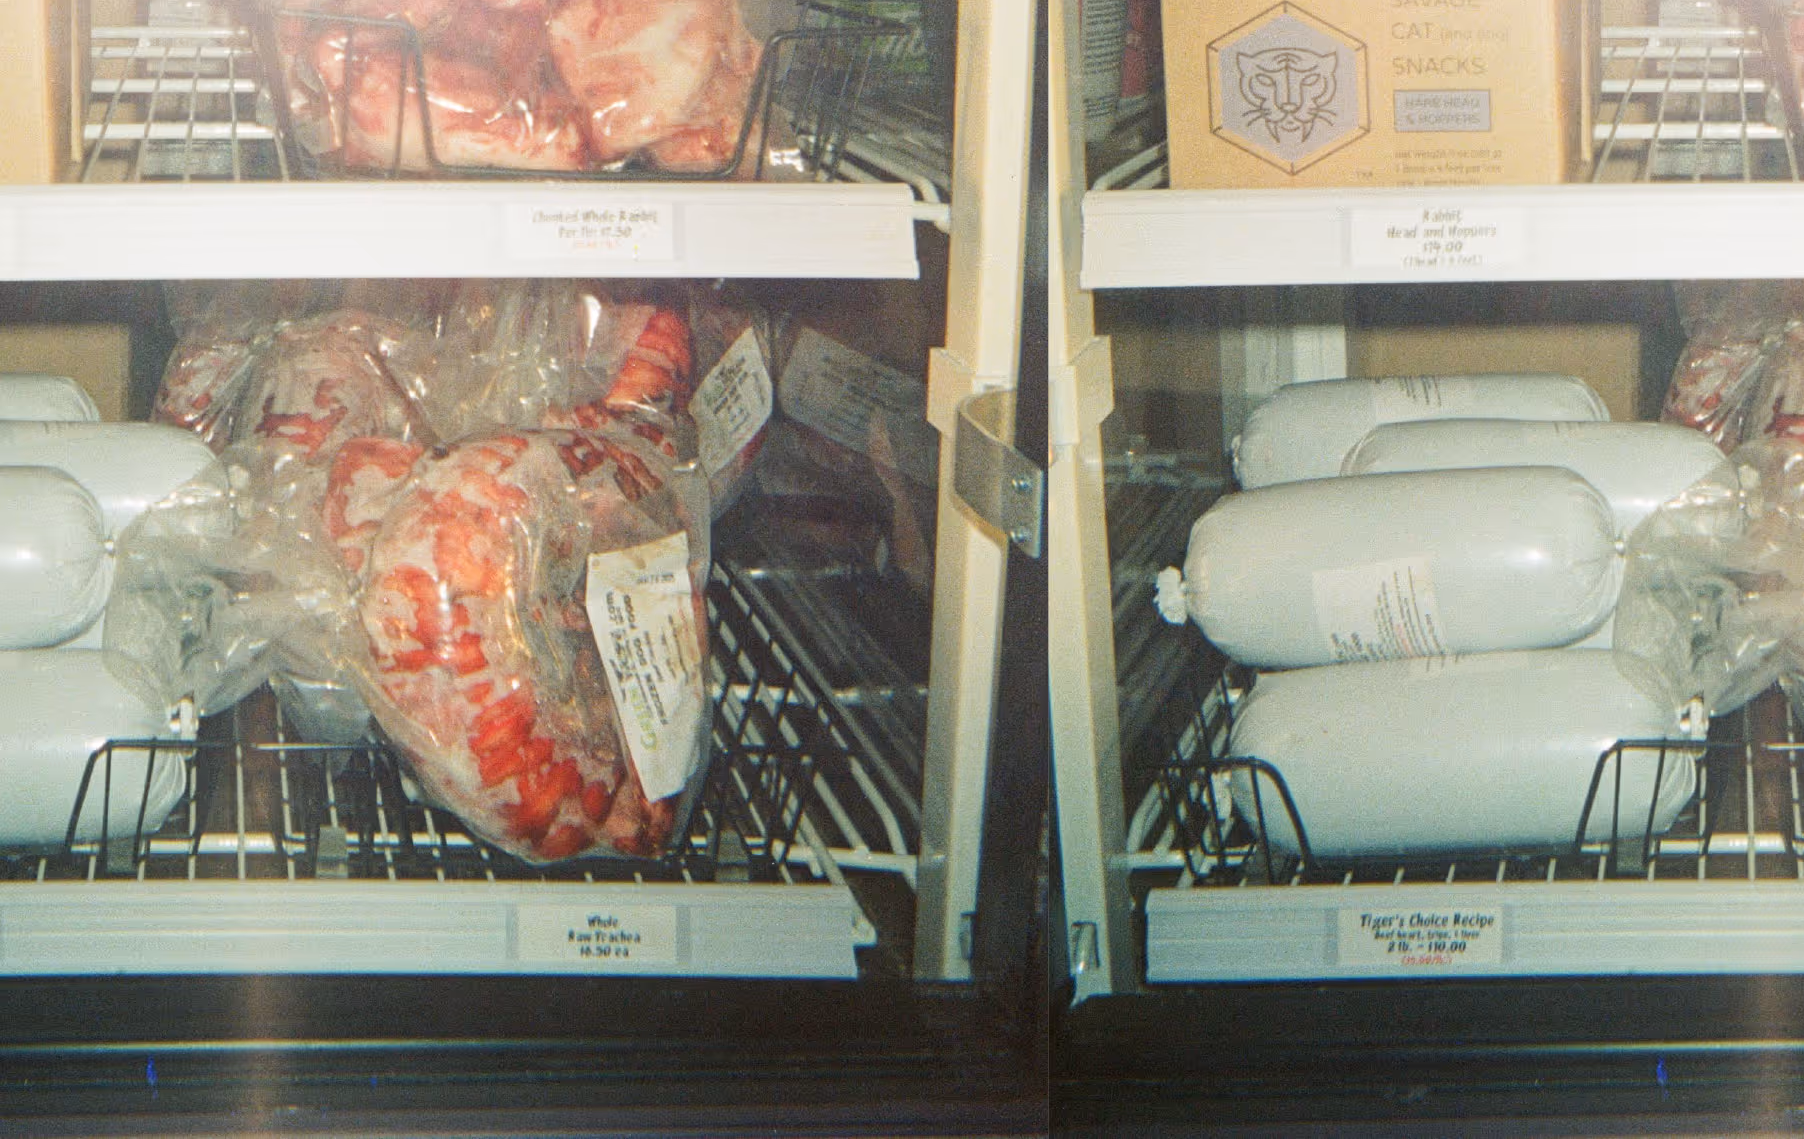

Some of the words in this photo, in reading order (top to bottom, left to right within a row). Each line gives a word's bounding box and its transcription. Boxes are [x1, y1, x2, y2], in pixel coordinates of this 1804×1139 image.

[1391, 22, 1434, 40] CAT
[1392, 56, 1489, 76] SNACKS
[1386, 224, 1417, 239] Head
[1423, 225, 1444, 239] and
[587, 913, 619, 928] Whole
[1360, 912, 1405, 931] Tiger's
[1409, 911, 1449, 928] Choice
[1453, 912, 1495, 929] Recipe
[567, 928, 592, 943] Raw
[1387, 941, 1395, 953] 2
